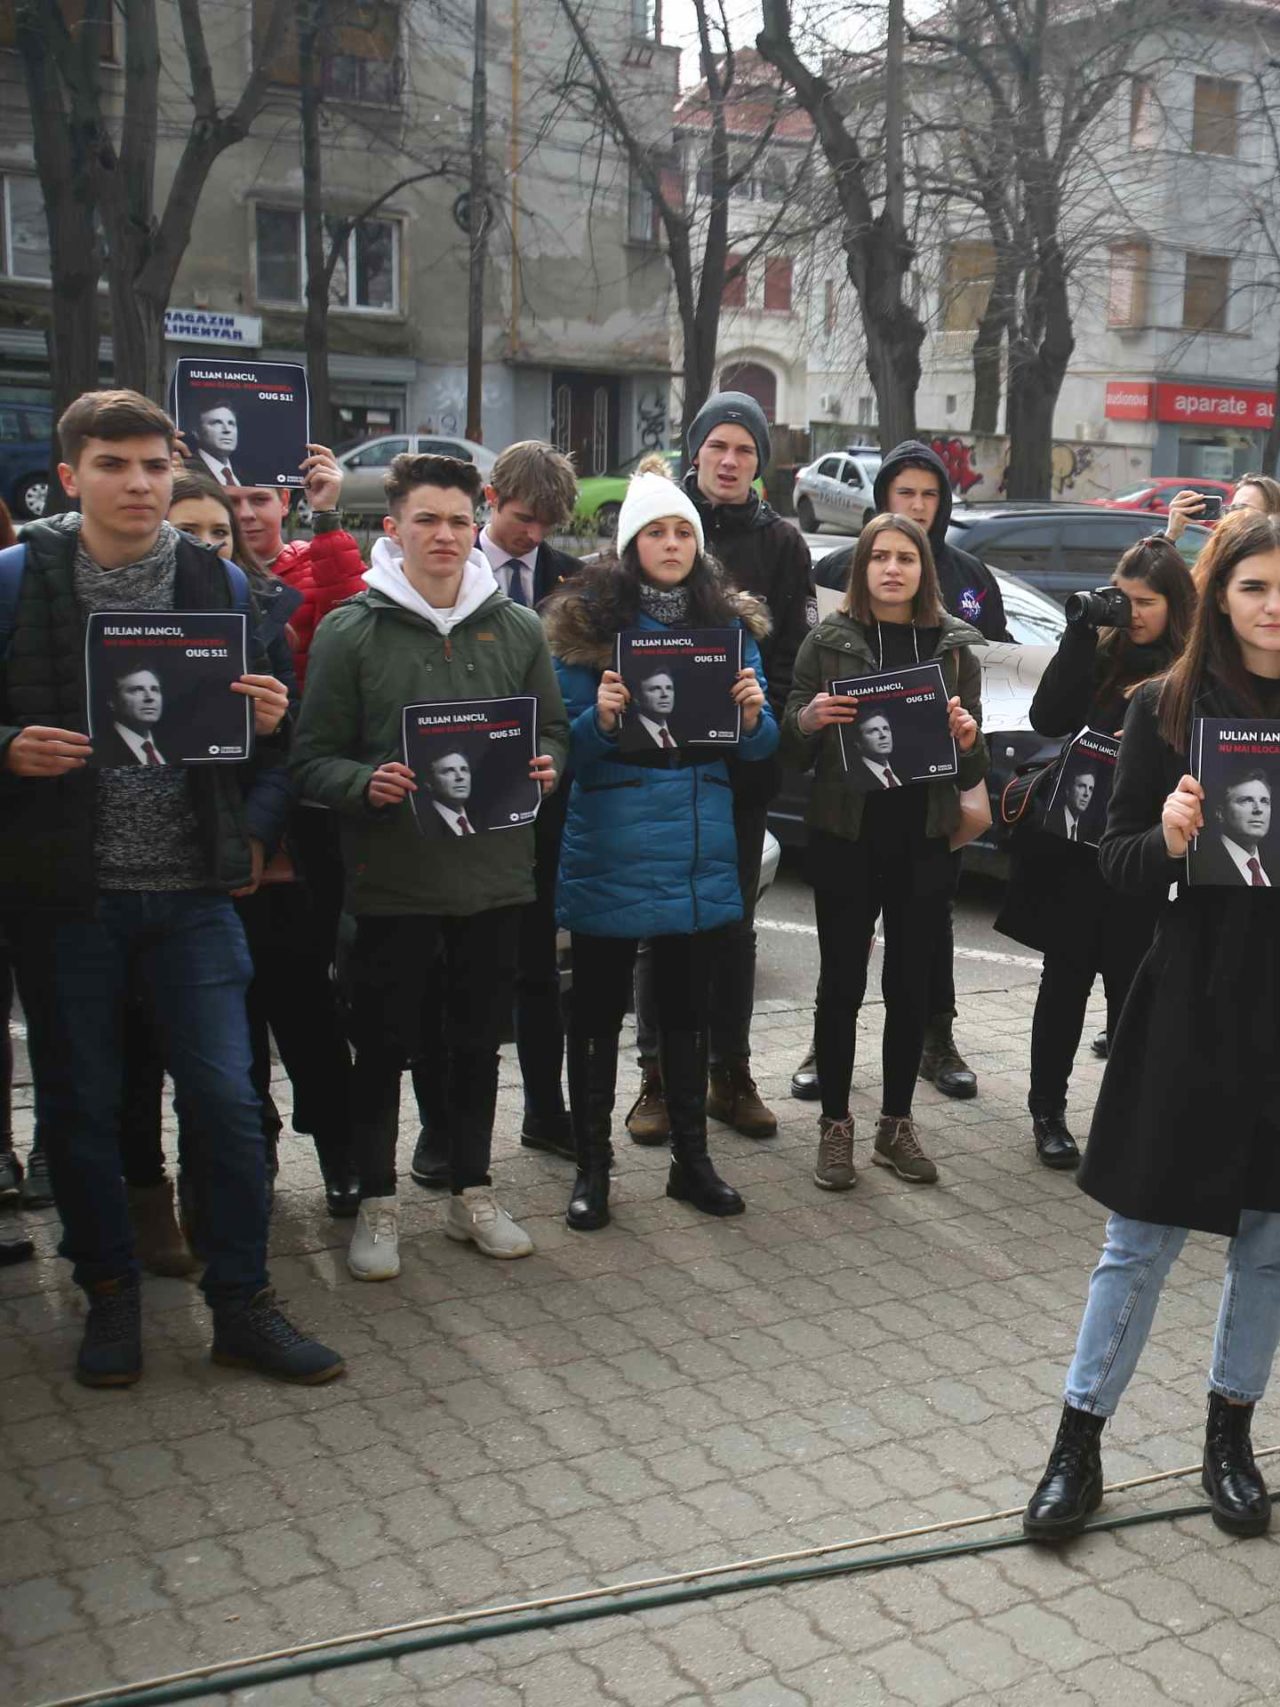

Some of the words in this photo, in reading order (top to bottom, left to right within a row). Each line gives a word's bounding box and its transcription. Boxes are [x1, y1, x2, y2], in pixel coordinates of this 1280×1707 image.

[164, 324, 243, 340] LIMENTAR
[190, 370, 222, 380] IULIAN
[224, 372, 258, 383] IANCU,
[258, 392, 279, 401] OUG
[280, 393, 294, 402] 51!
[1175, 395, 1247, 415] aparate
[104, 627, 142, 636] IULIAN
[144, 627, 184, 638] IANCU,
[631, 639, 661, 647] IULIAN
[663, 638, 694, 647] IANCU,
[185, 648, 210, 658] OUG
[211, 649, 228, 658] 51!
[694, 655, 713, 663] OUG
[714, 654, 727, 663] 51!
[847, 685, 875, 697] IULIAN
[875, 682, 904, 693] IANCU,
[906, 693, 923, 704] OUG
[923, 692, 936, 702] 51!
[418, 715, 451, 725] IULIAN
[489, 730, 507, 740] OUG
[1220, 731, 1258, 741] IULIAN
